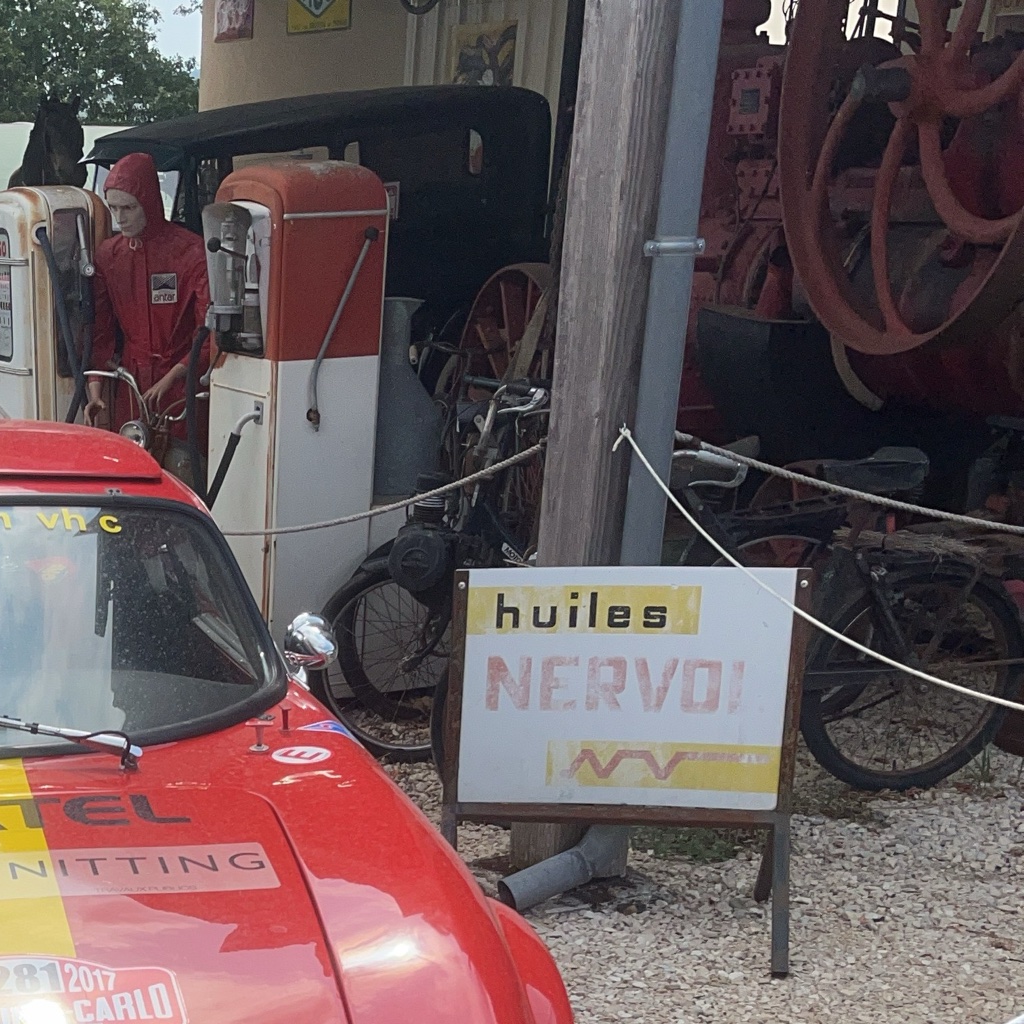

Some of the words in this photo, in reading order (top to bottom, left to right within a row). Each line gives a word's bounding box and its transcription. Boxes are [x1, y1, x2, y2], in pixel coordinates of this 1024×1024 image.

[153, 293, 176, 302] antar
[495, 591, 668, 629] huiles
[8, 852, 267, 880] NITTING
[64, 962, 117, 993] 2017
